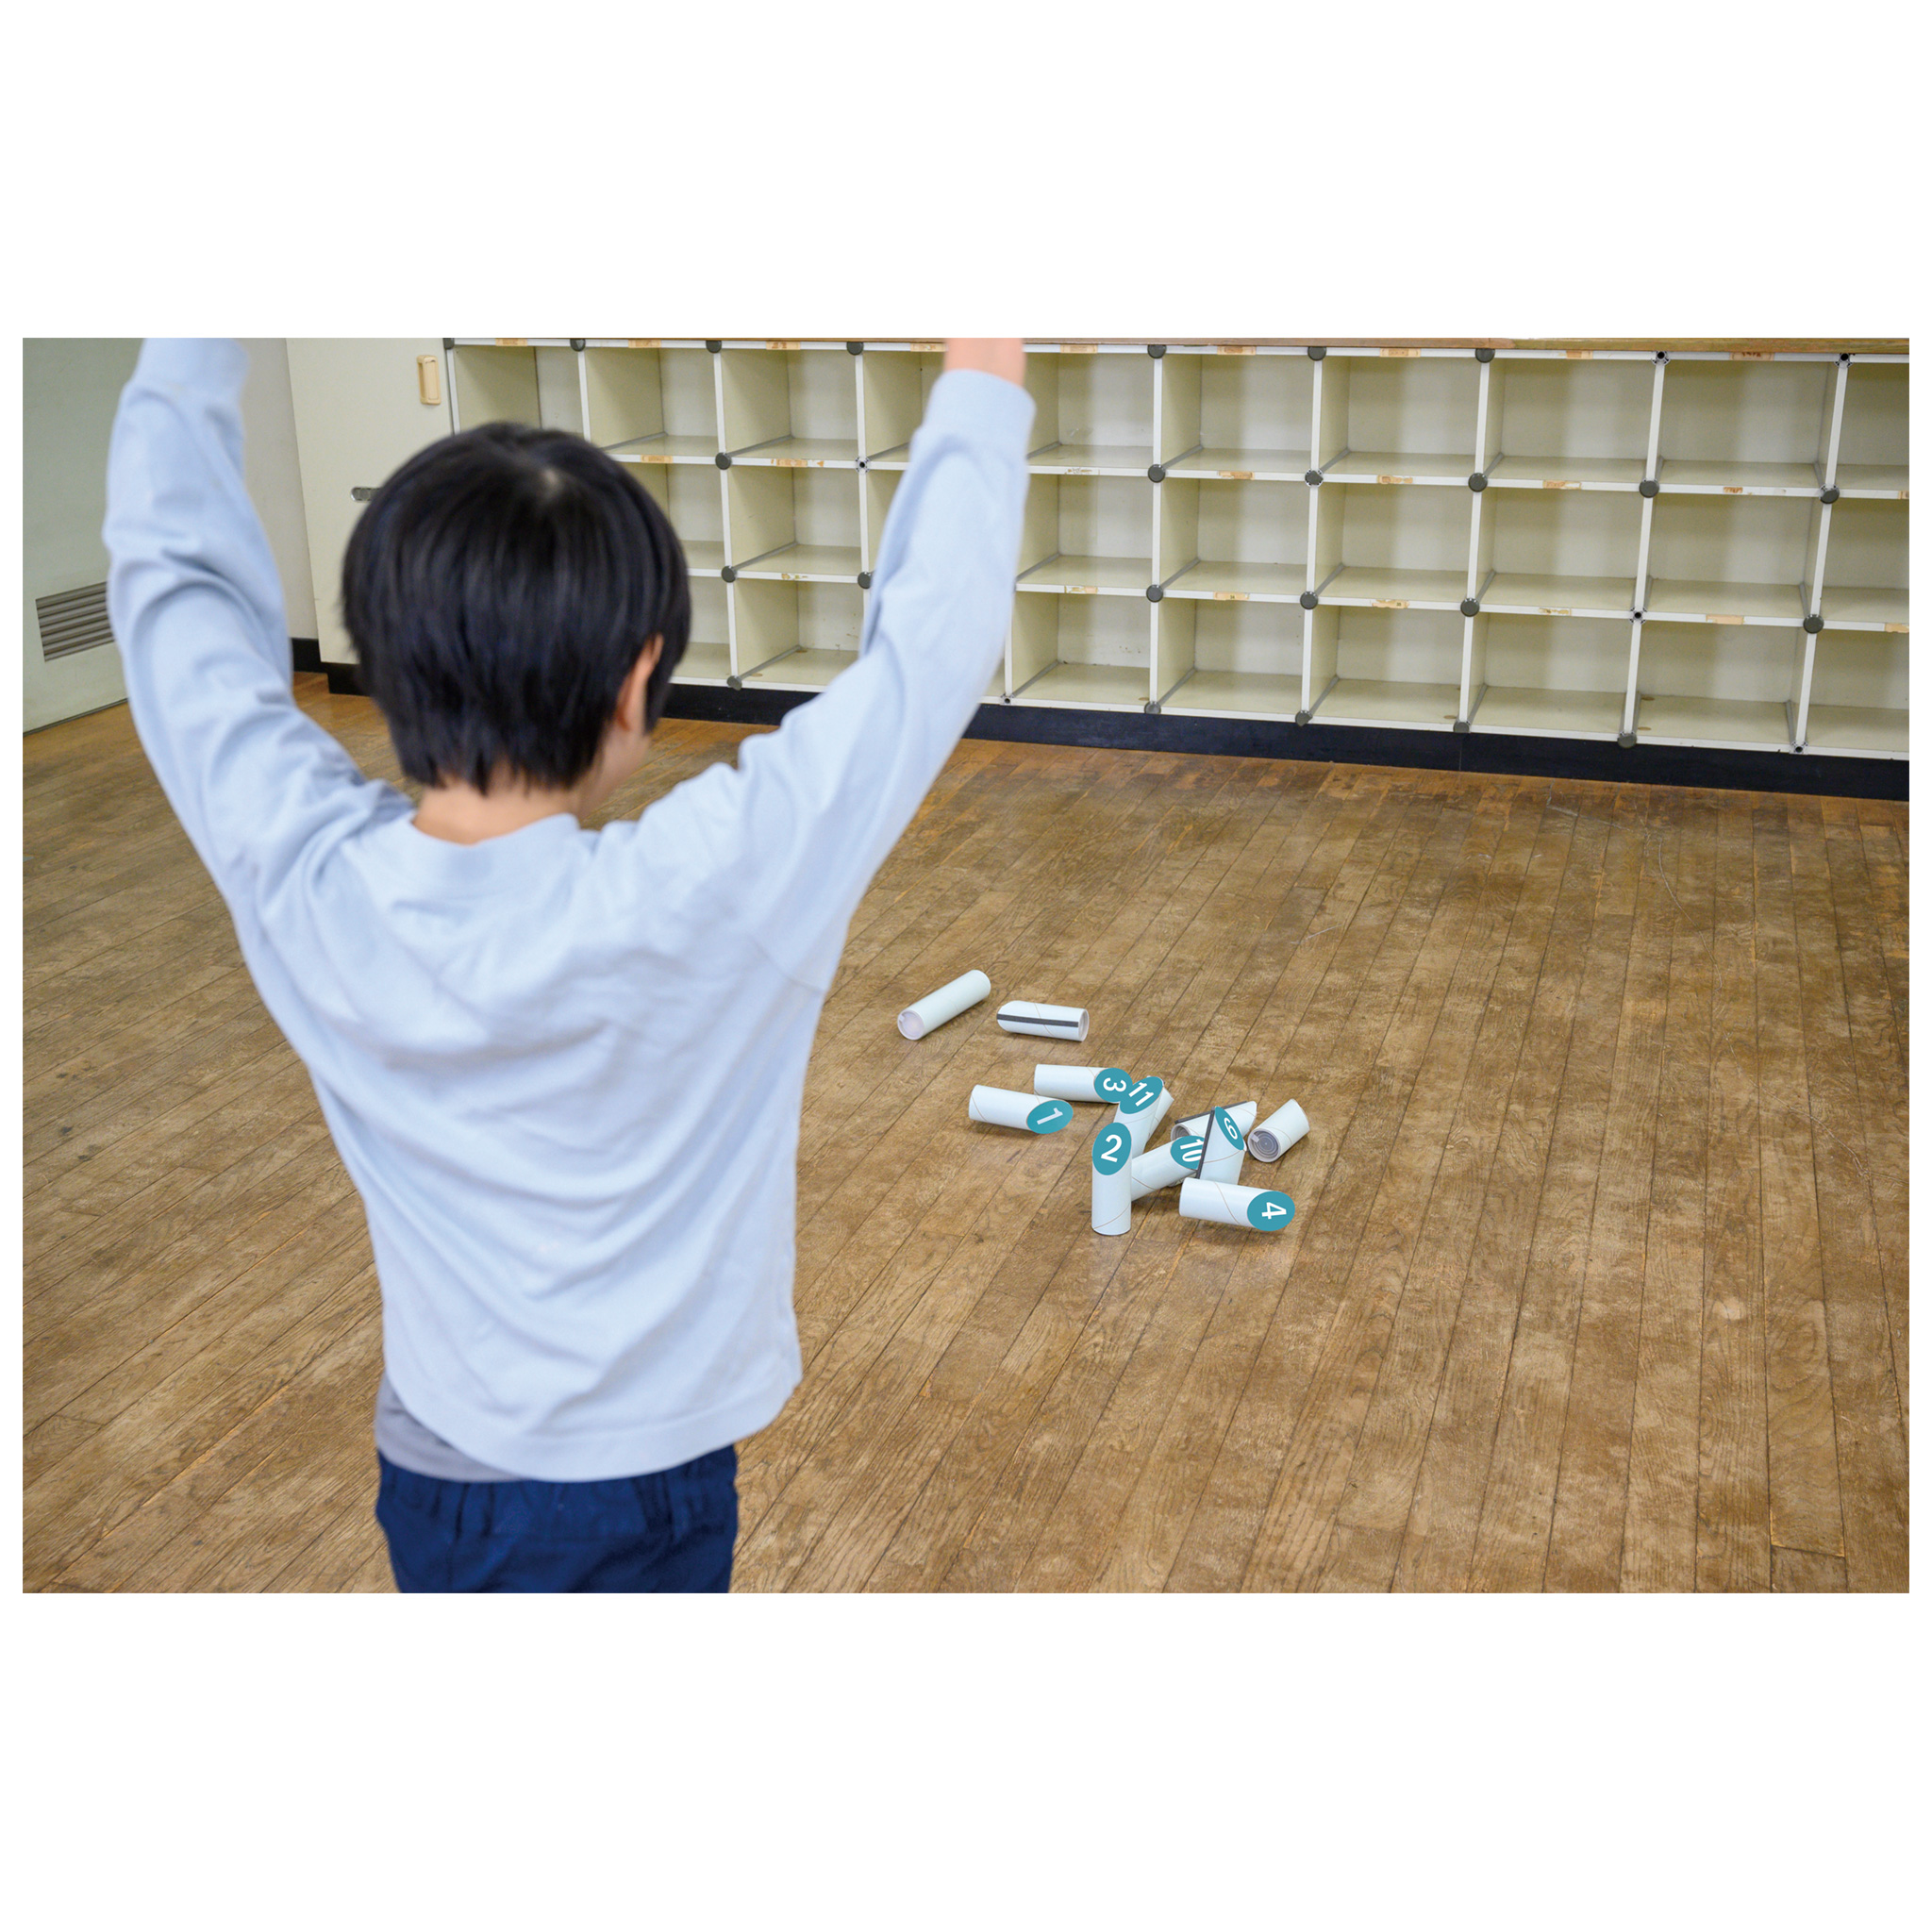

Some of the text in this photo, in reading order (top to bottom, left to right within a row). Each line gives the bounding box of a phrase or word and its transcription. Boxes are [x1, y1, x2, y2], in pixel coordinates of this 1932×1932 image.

[1104, 1078, 1126, 1092] 3
[1129, 1081, 1155, 1107] 11
[1037, 1108, 1063, 1125] 1
[1224, 1117, 1239, 1141] 6
[1101, 1134, 1123, 1162] 2
[1180, 1139, 1204, 1162] 10
[1261, 1202, 1287, 1220] 4
